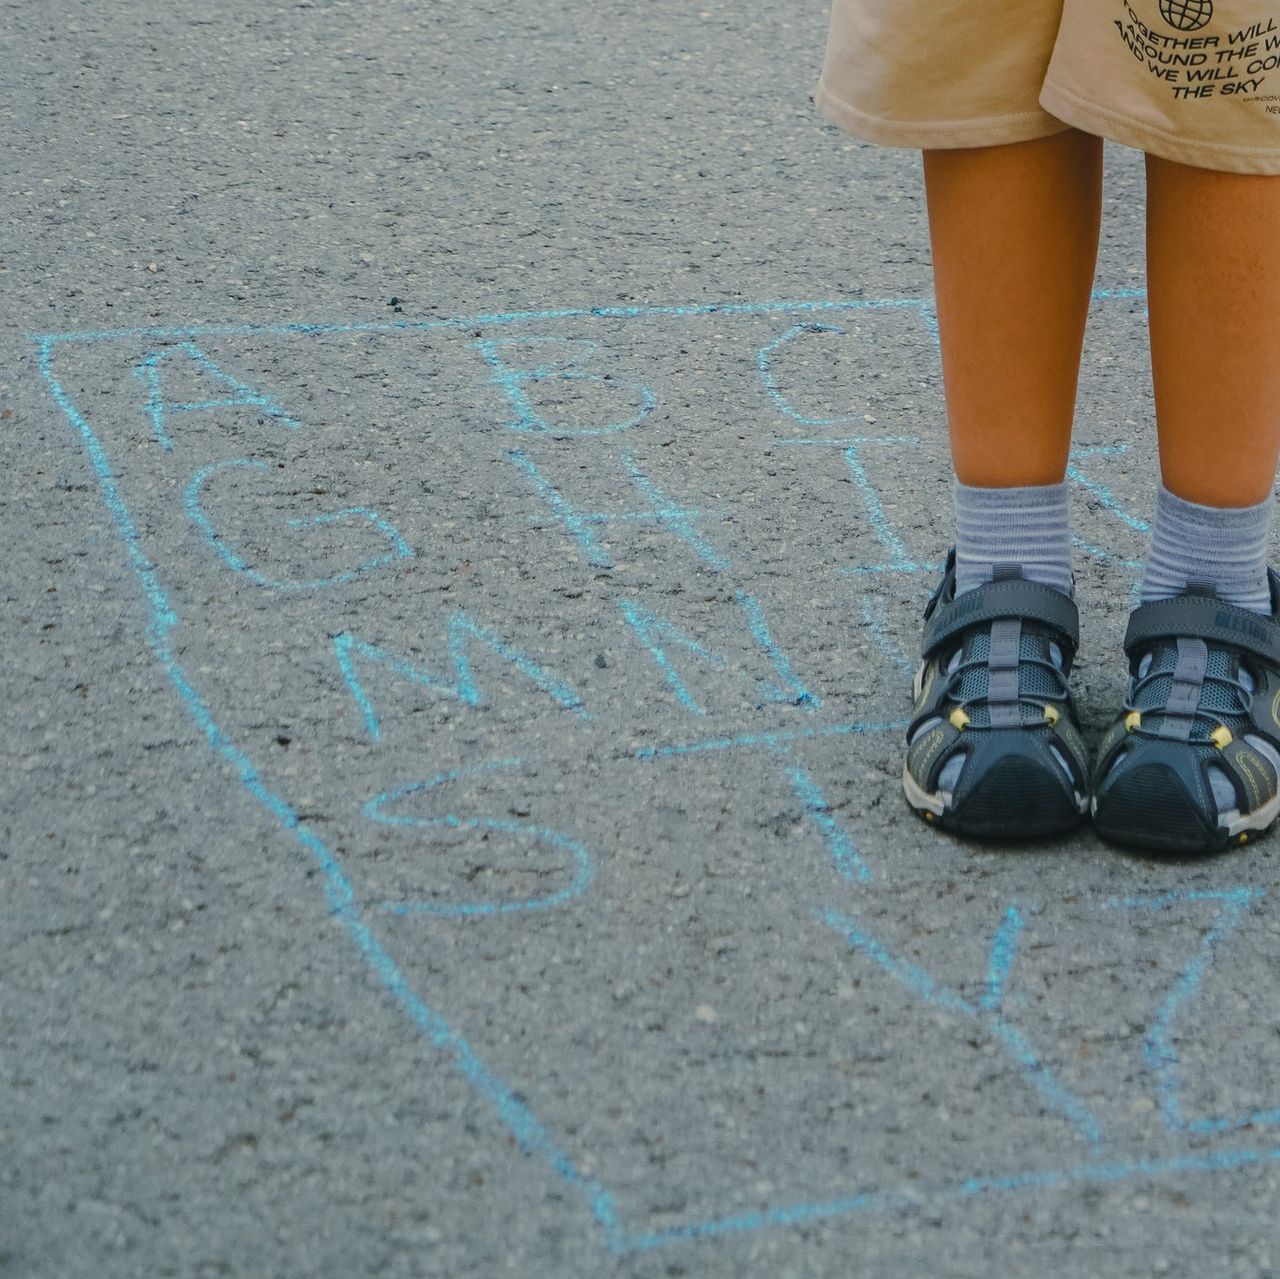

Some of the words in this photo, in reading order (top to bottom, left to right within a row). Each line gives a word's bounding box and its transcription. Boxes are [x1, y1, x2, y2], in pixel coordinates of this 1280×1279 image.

[1126, 24, 1207, 67] AROUND
[1214, 42, 1260, 64] THE
[1228, 17, 1278, 45] WILL
[1113, 20, 1144, 63] AND
[1147, 60, 1180, 83] WE
[1186, 67, 1240, 83] WILL
[1171, 84, 1215, 100] THE
[1220, 76, 1266, 96] SKY
